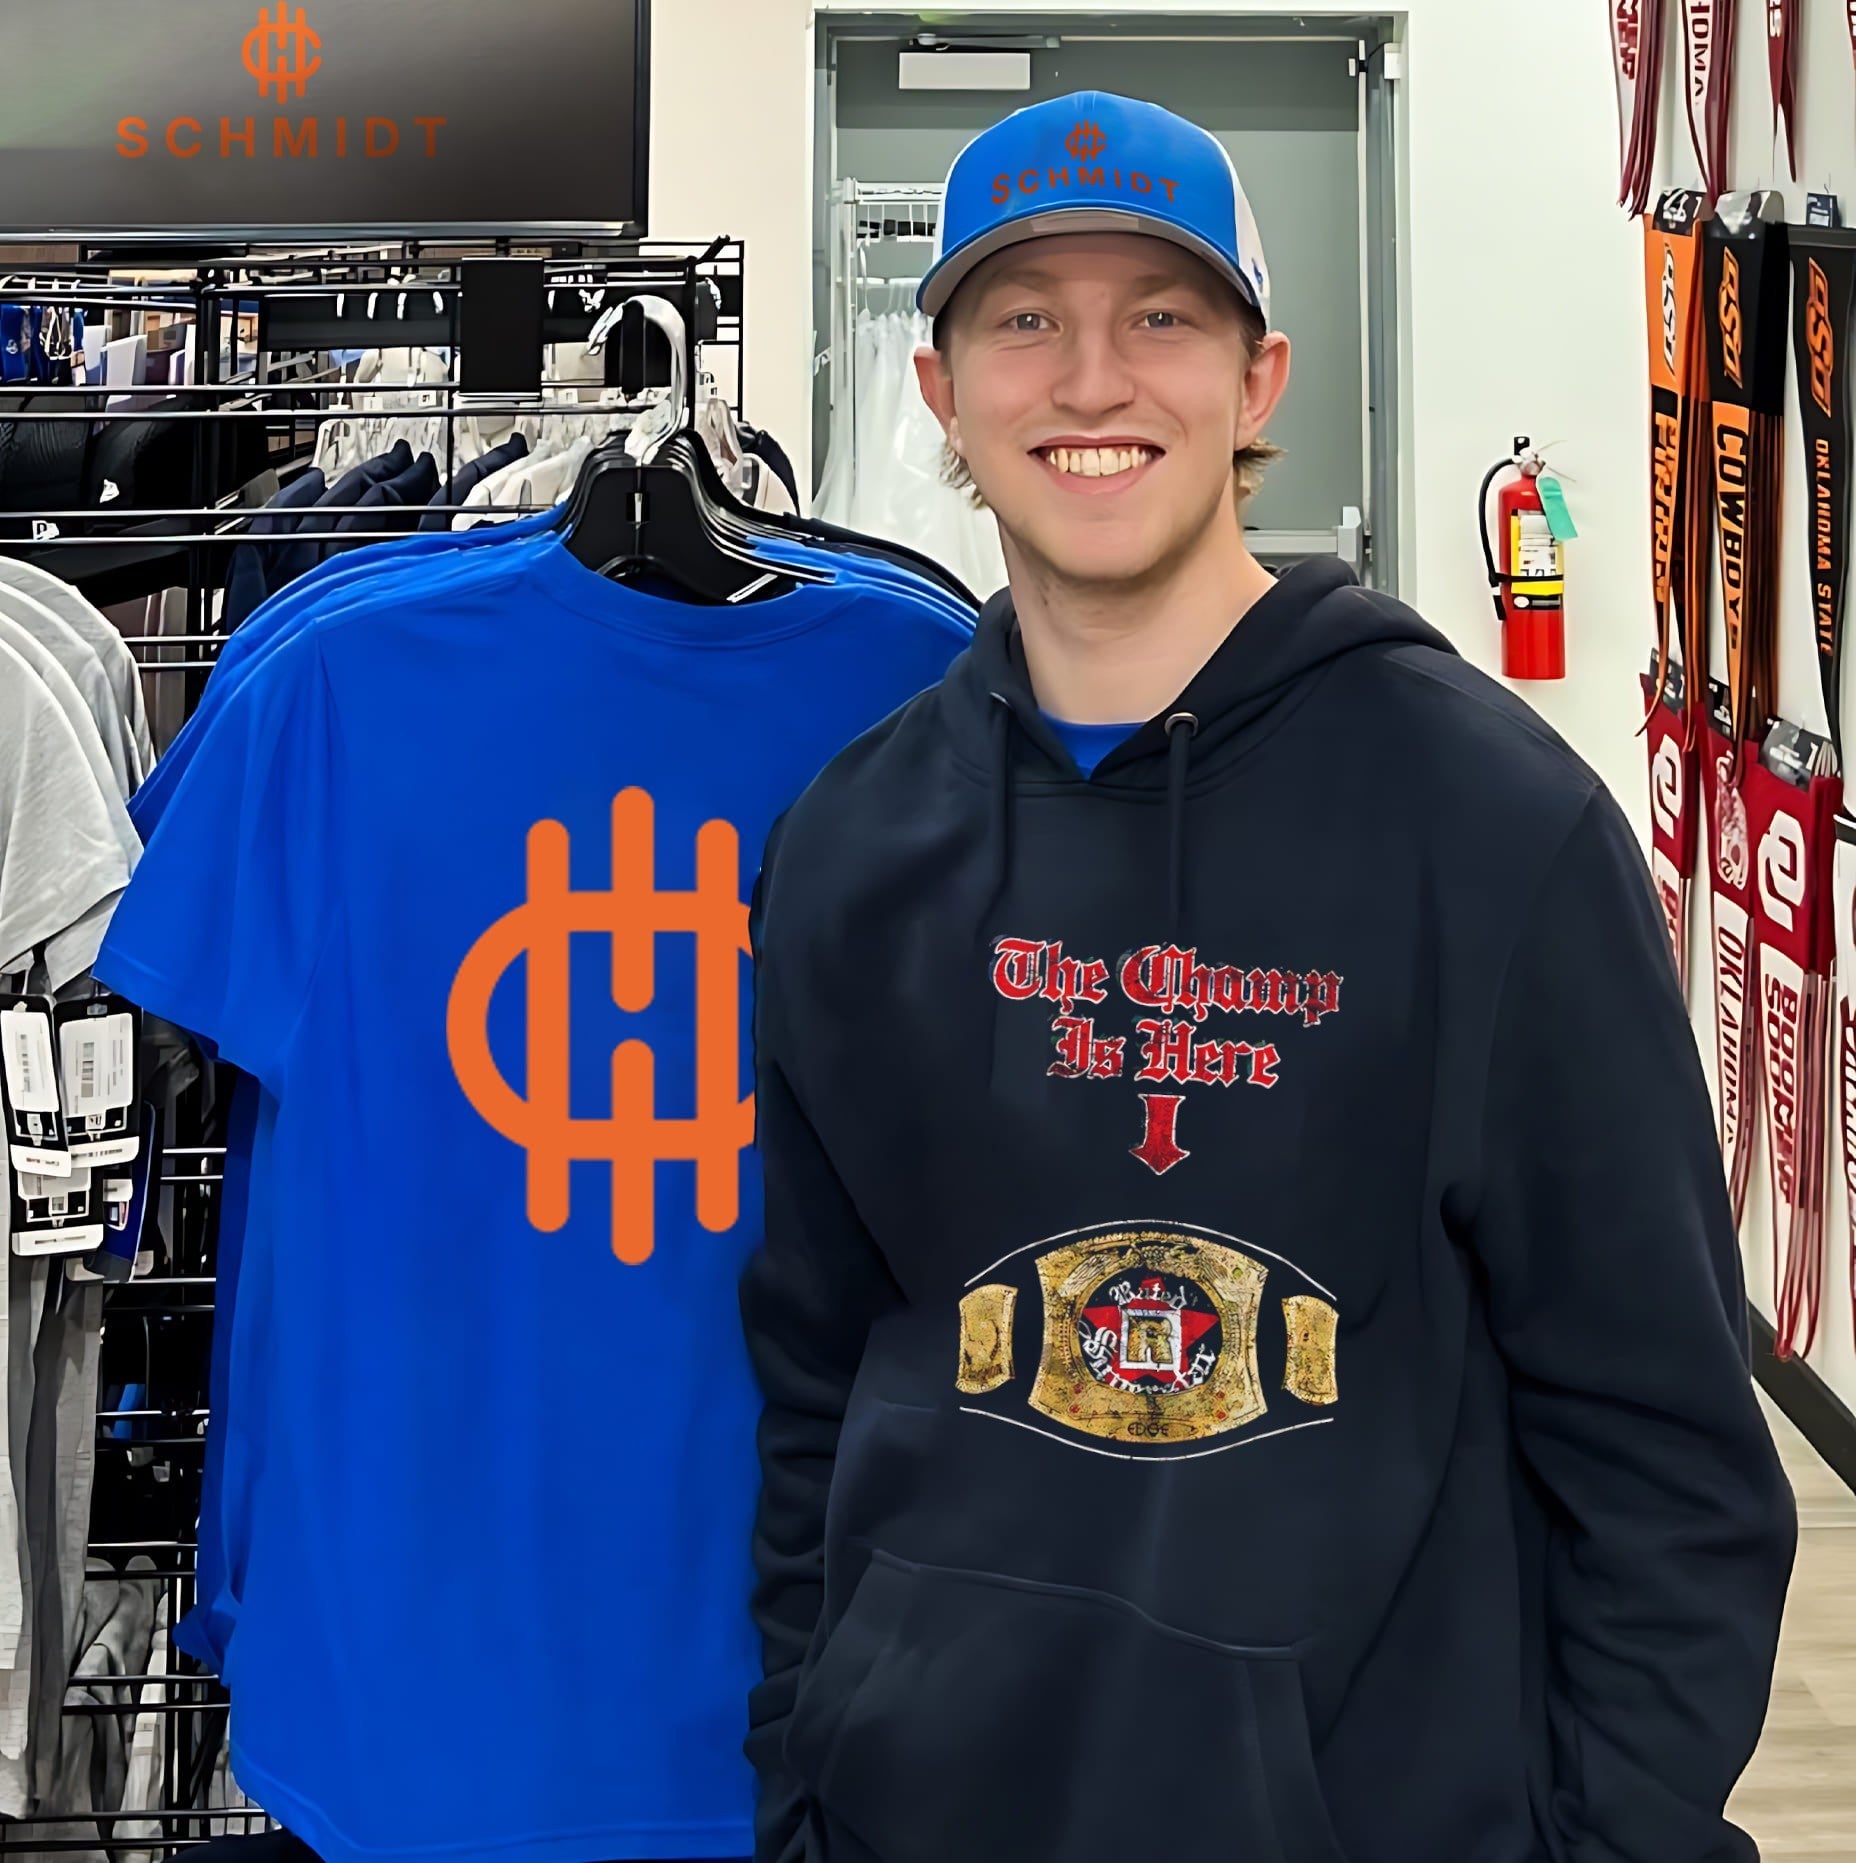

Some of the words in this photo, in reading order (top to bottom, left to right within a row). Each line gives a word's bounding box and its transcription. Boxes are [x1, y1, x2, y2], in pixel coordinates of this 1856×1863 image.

[116, 117, 447, 158] SCHMIDT
[991, 167, 1179, 205] SCHMIDT
[1815, 438, 1832, 570] OKLAHOMA
[993, 937, 1110, 1015] The
[1119, 943, 1344, 1028] Champ
[1046, 1015, 1126, 1078] Is
[1133, 1018, 1281, 1089] Here
[1717, 926, 1746, 1144] OKLAHOMA
